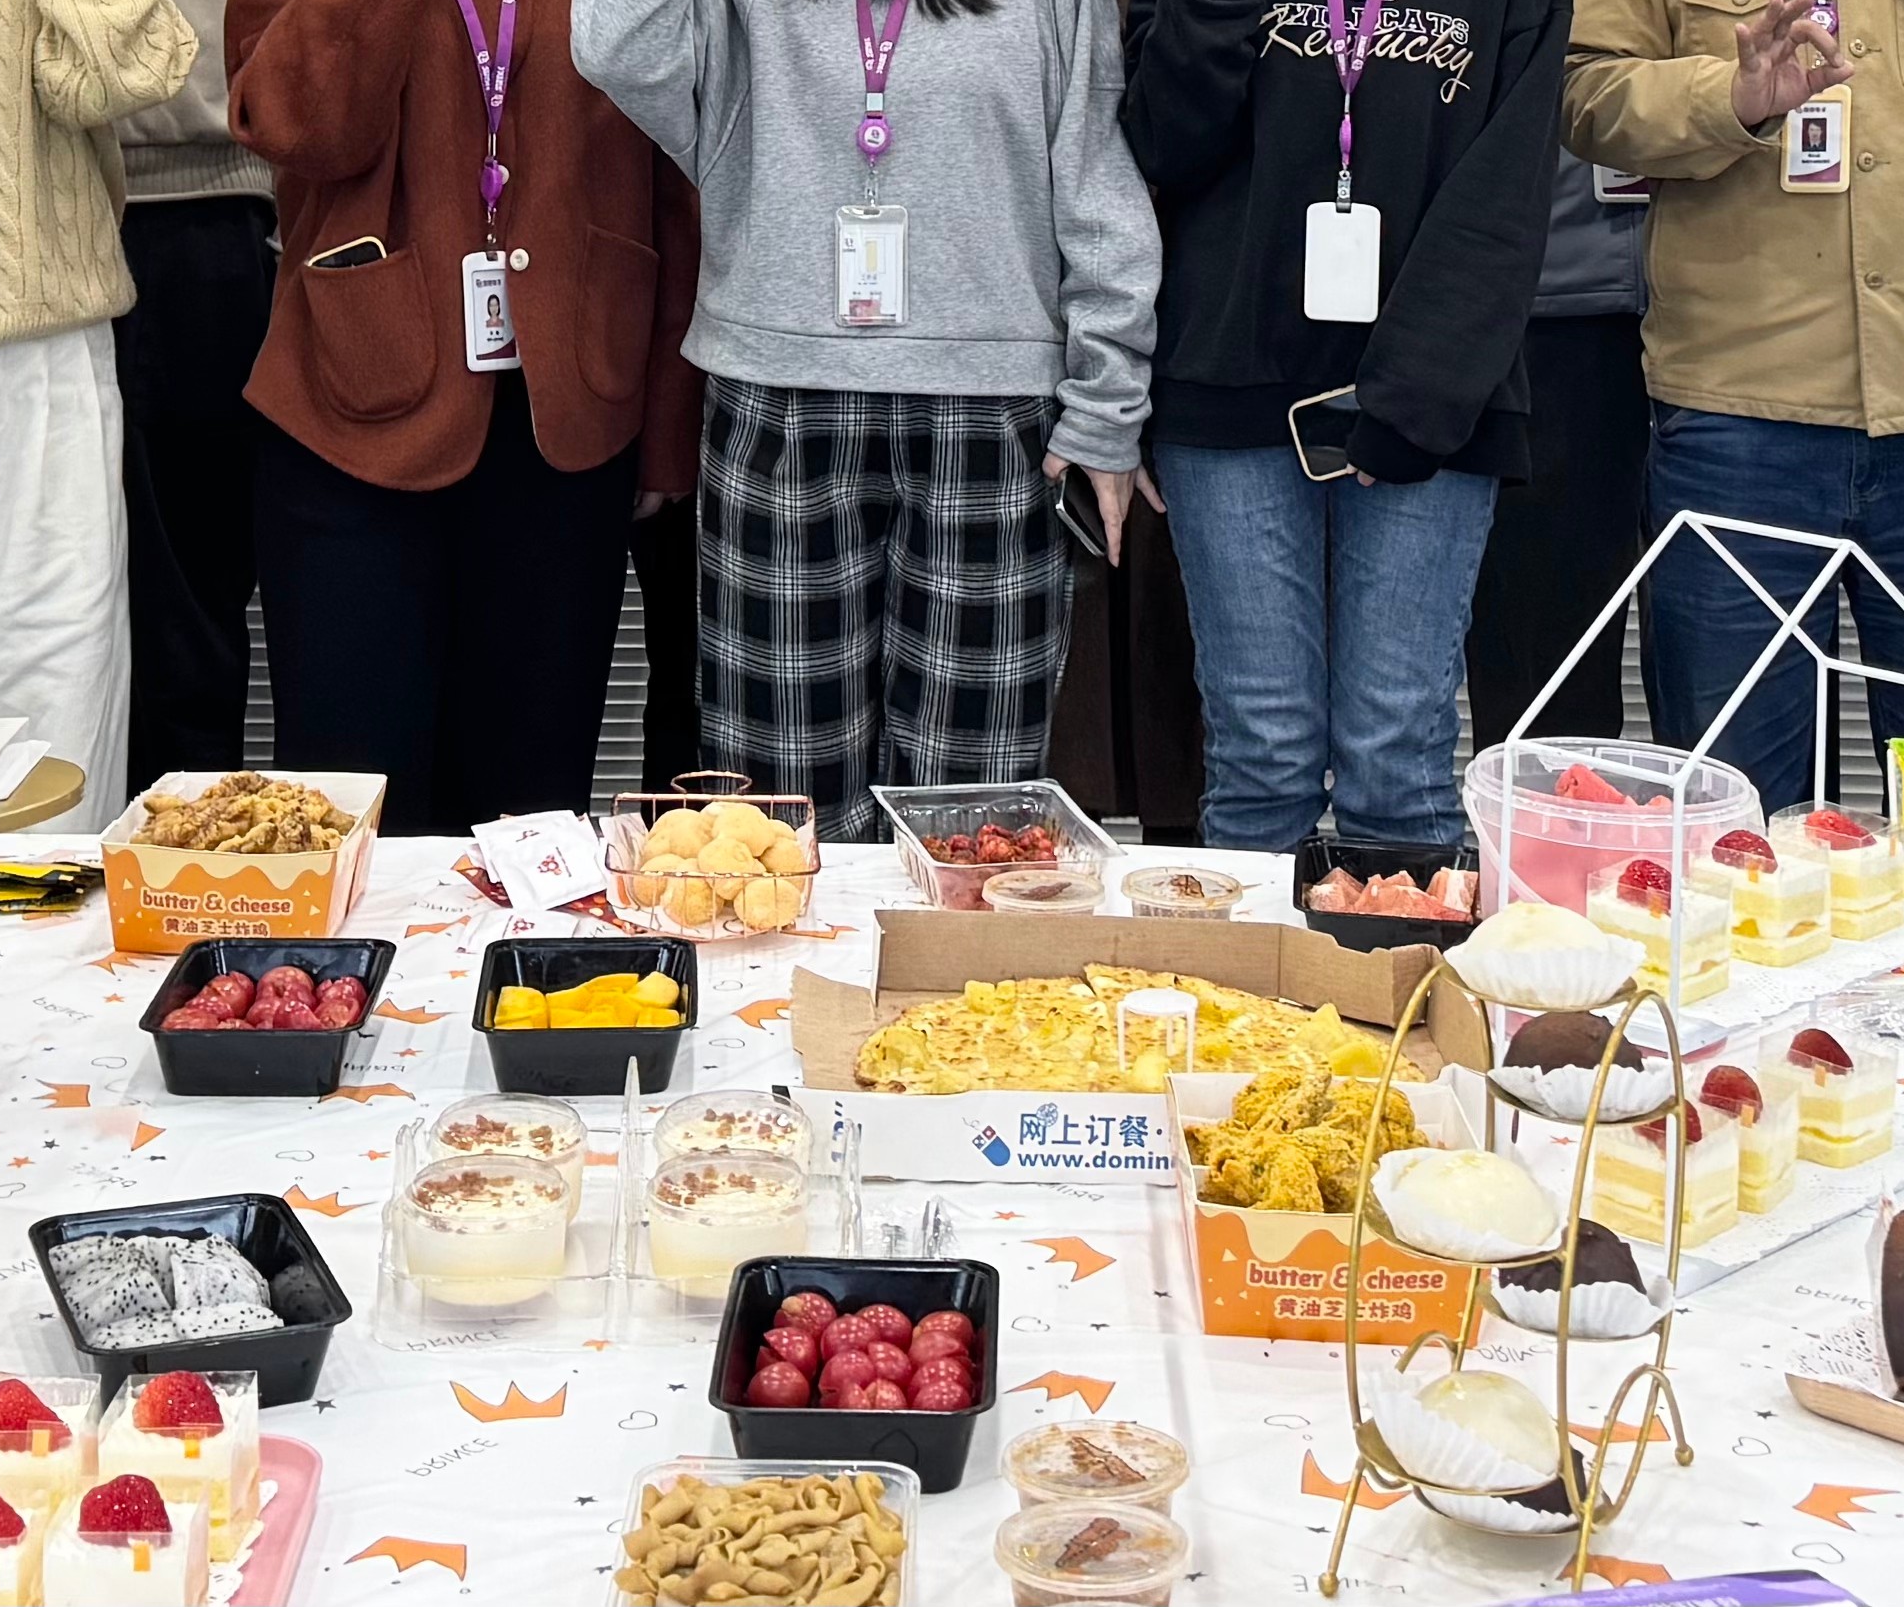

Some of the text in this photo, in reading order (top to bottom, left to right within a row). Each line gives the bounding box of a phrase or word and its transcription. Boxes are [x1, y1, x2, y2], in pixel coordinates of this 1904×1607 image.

[143, 889, 291, 913] butter & cheese
[165, 918, 268, 936] 黄油芝士炸鸡
[1249, 1263, 1323, 1287] butter
[1366, 1270, 1444, 1289] cheese
